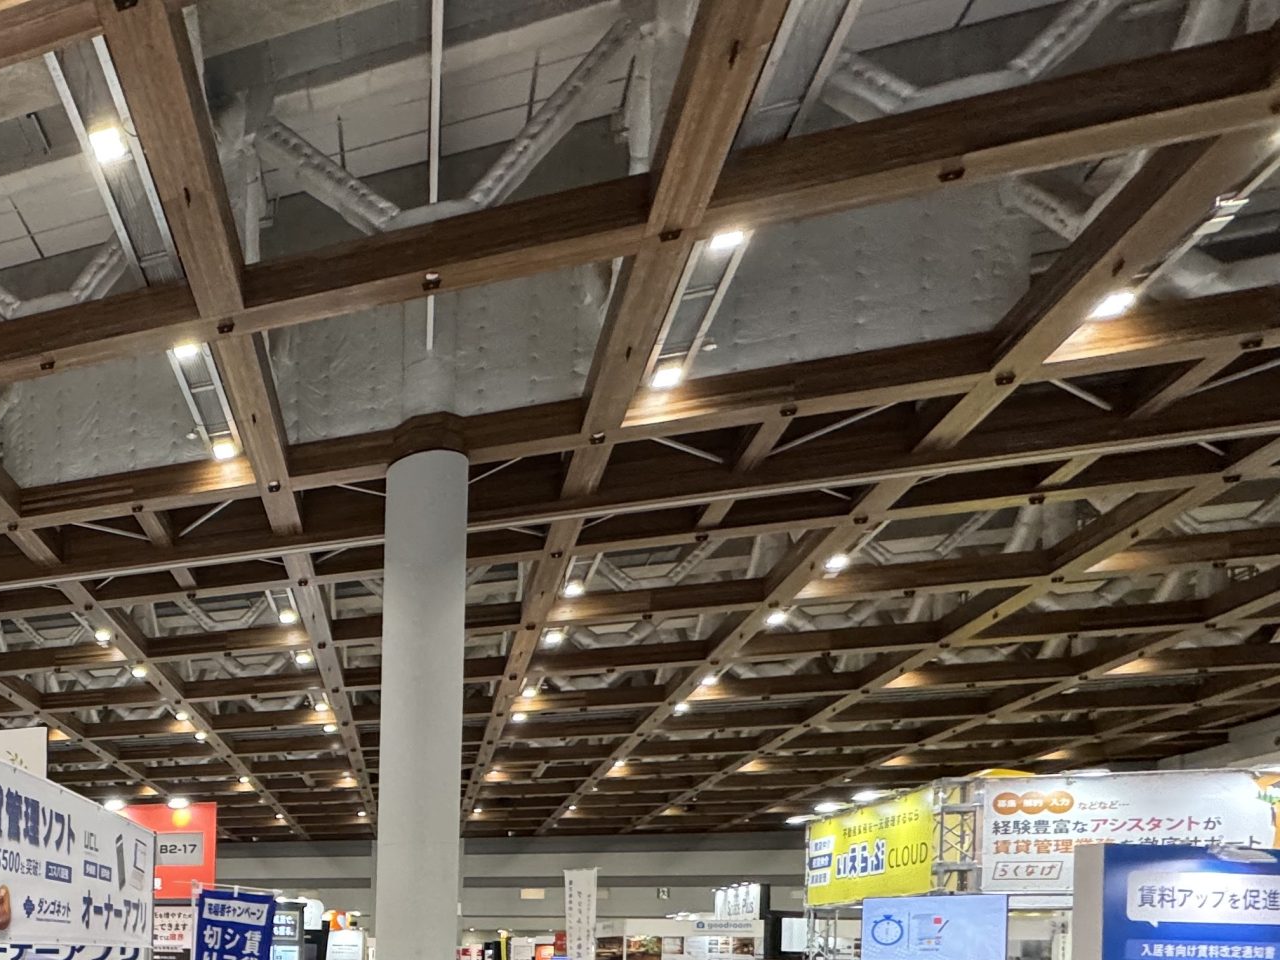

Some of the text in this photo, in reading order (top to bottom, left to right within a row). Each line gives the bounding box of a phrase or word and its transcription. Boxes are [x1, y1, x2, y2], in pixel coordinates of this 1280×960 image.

[1049, 796, 1071, 807] 入力
[992, 816, 1222, 836] 経験豊富なアシスタントが
[160, 844, 198, 854] B2-17
[836, 840, 929, 876] いえらぶ CLOUD
[999, 864, 1057, 878] らくなげ
[37, 897, 71, 918] ダンゴネット
[81, 888, 148, 934] オーナーアプリ
[1140, 943, 1277, 960] 入居者向け賃料改定通知書
